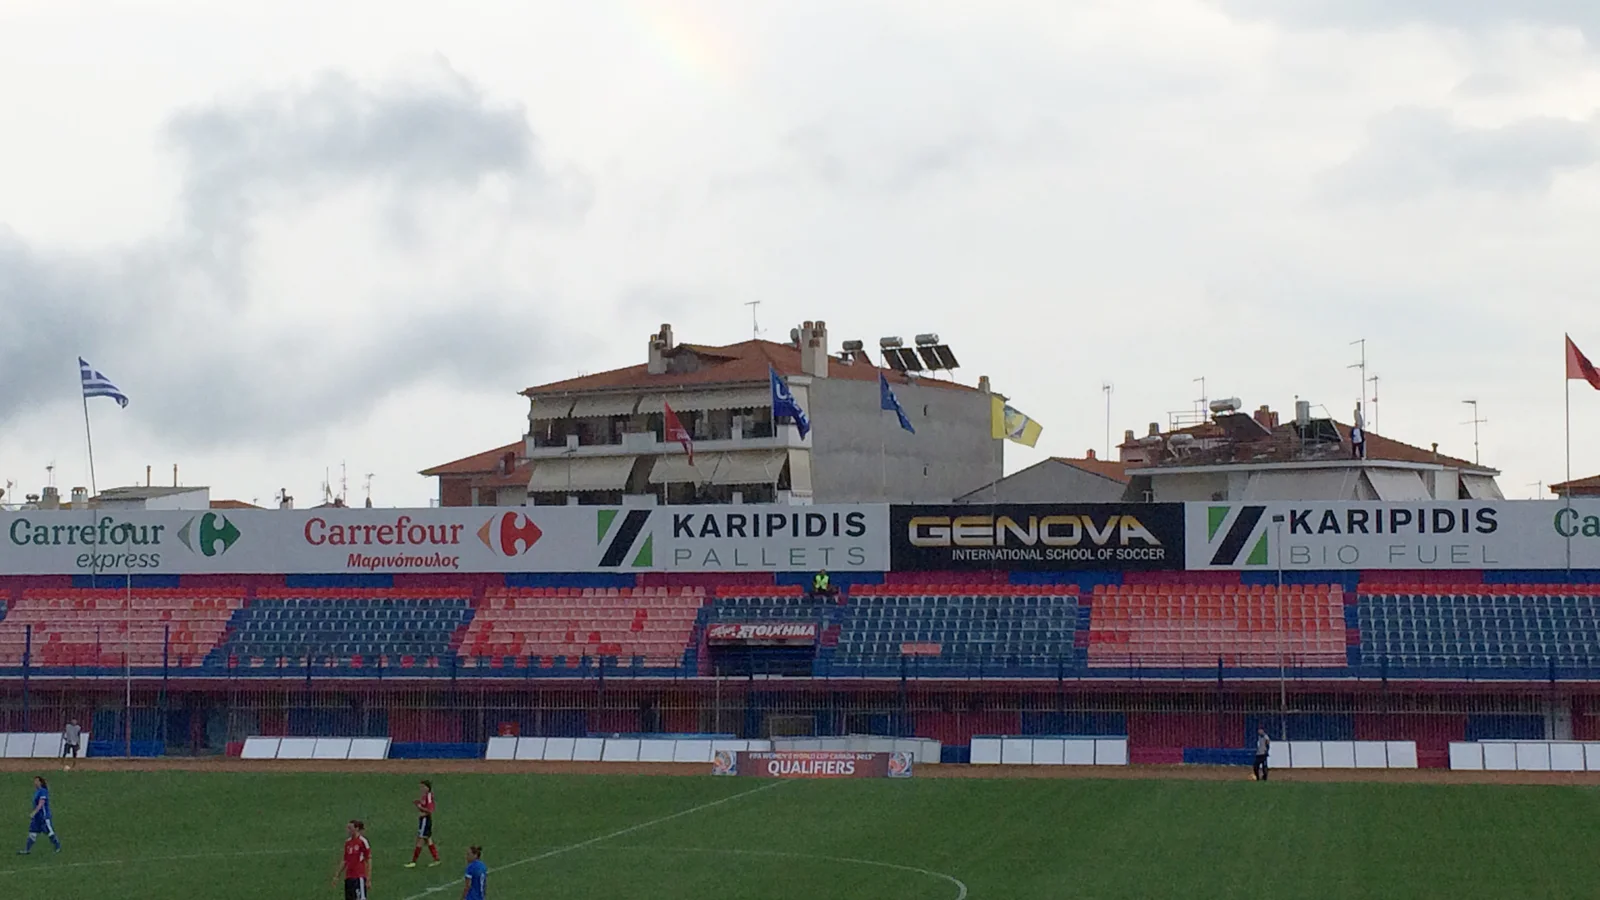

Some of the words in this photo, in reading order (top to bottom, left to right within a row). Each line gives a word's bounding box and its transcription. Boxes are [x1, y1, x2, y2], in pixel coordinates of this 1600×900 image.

[10, 516, 164, 545] Carrefour
[673, 511, 865, 537] KARIPIDIS
[907, 515, 1162, 546] GENOVA
[1290, 507, 1498, 534] KARIPIDIS
[304, 516, 464, 546] Carrefour
[76, 552, 161, 572] express
[346, 552, 460, 571] Μαρινόπουλος
[674, 548, 866, 566] PALLETS
[951, 548, 1044, 561] INTERNATIONAL
[1045, 548, 1095, 560] SCHOOL
[1097, 548, 1114, 560] OF
[1115, 547, 1165, 560] SOCCER
[1290, 545, 1360, 564] BIO
[1389, 545, 1498, 564] FUEL
[767, 760, 855, 776] QUALIFIERS
